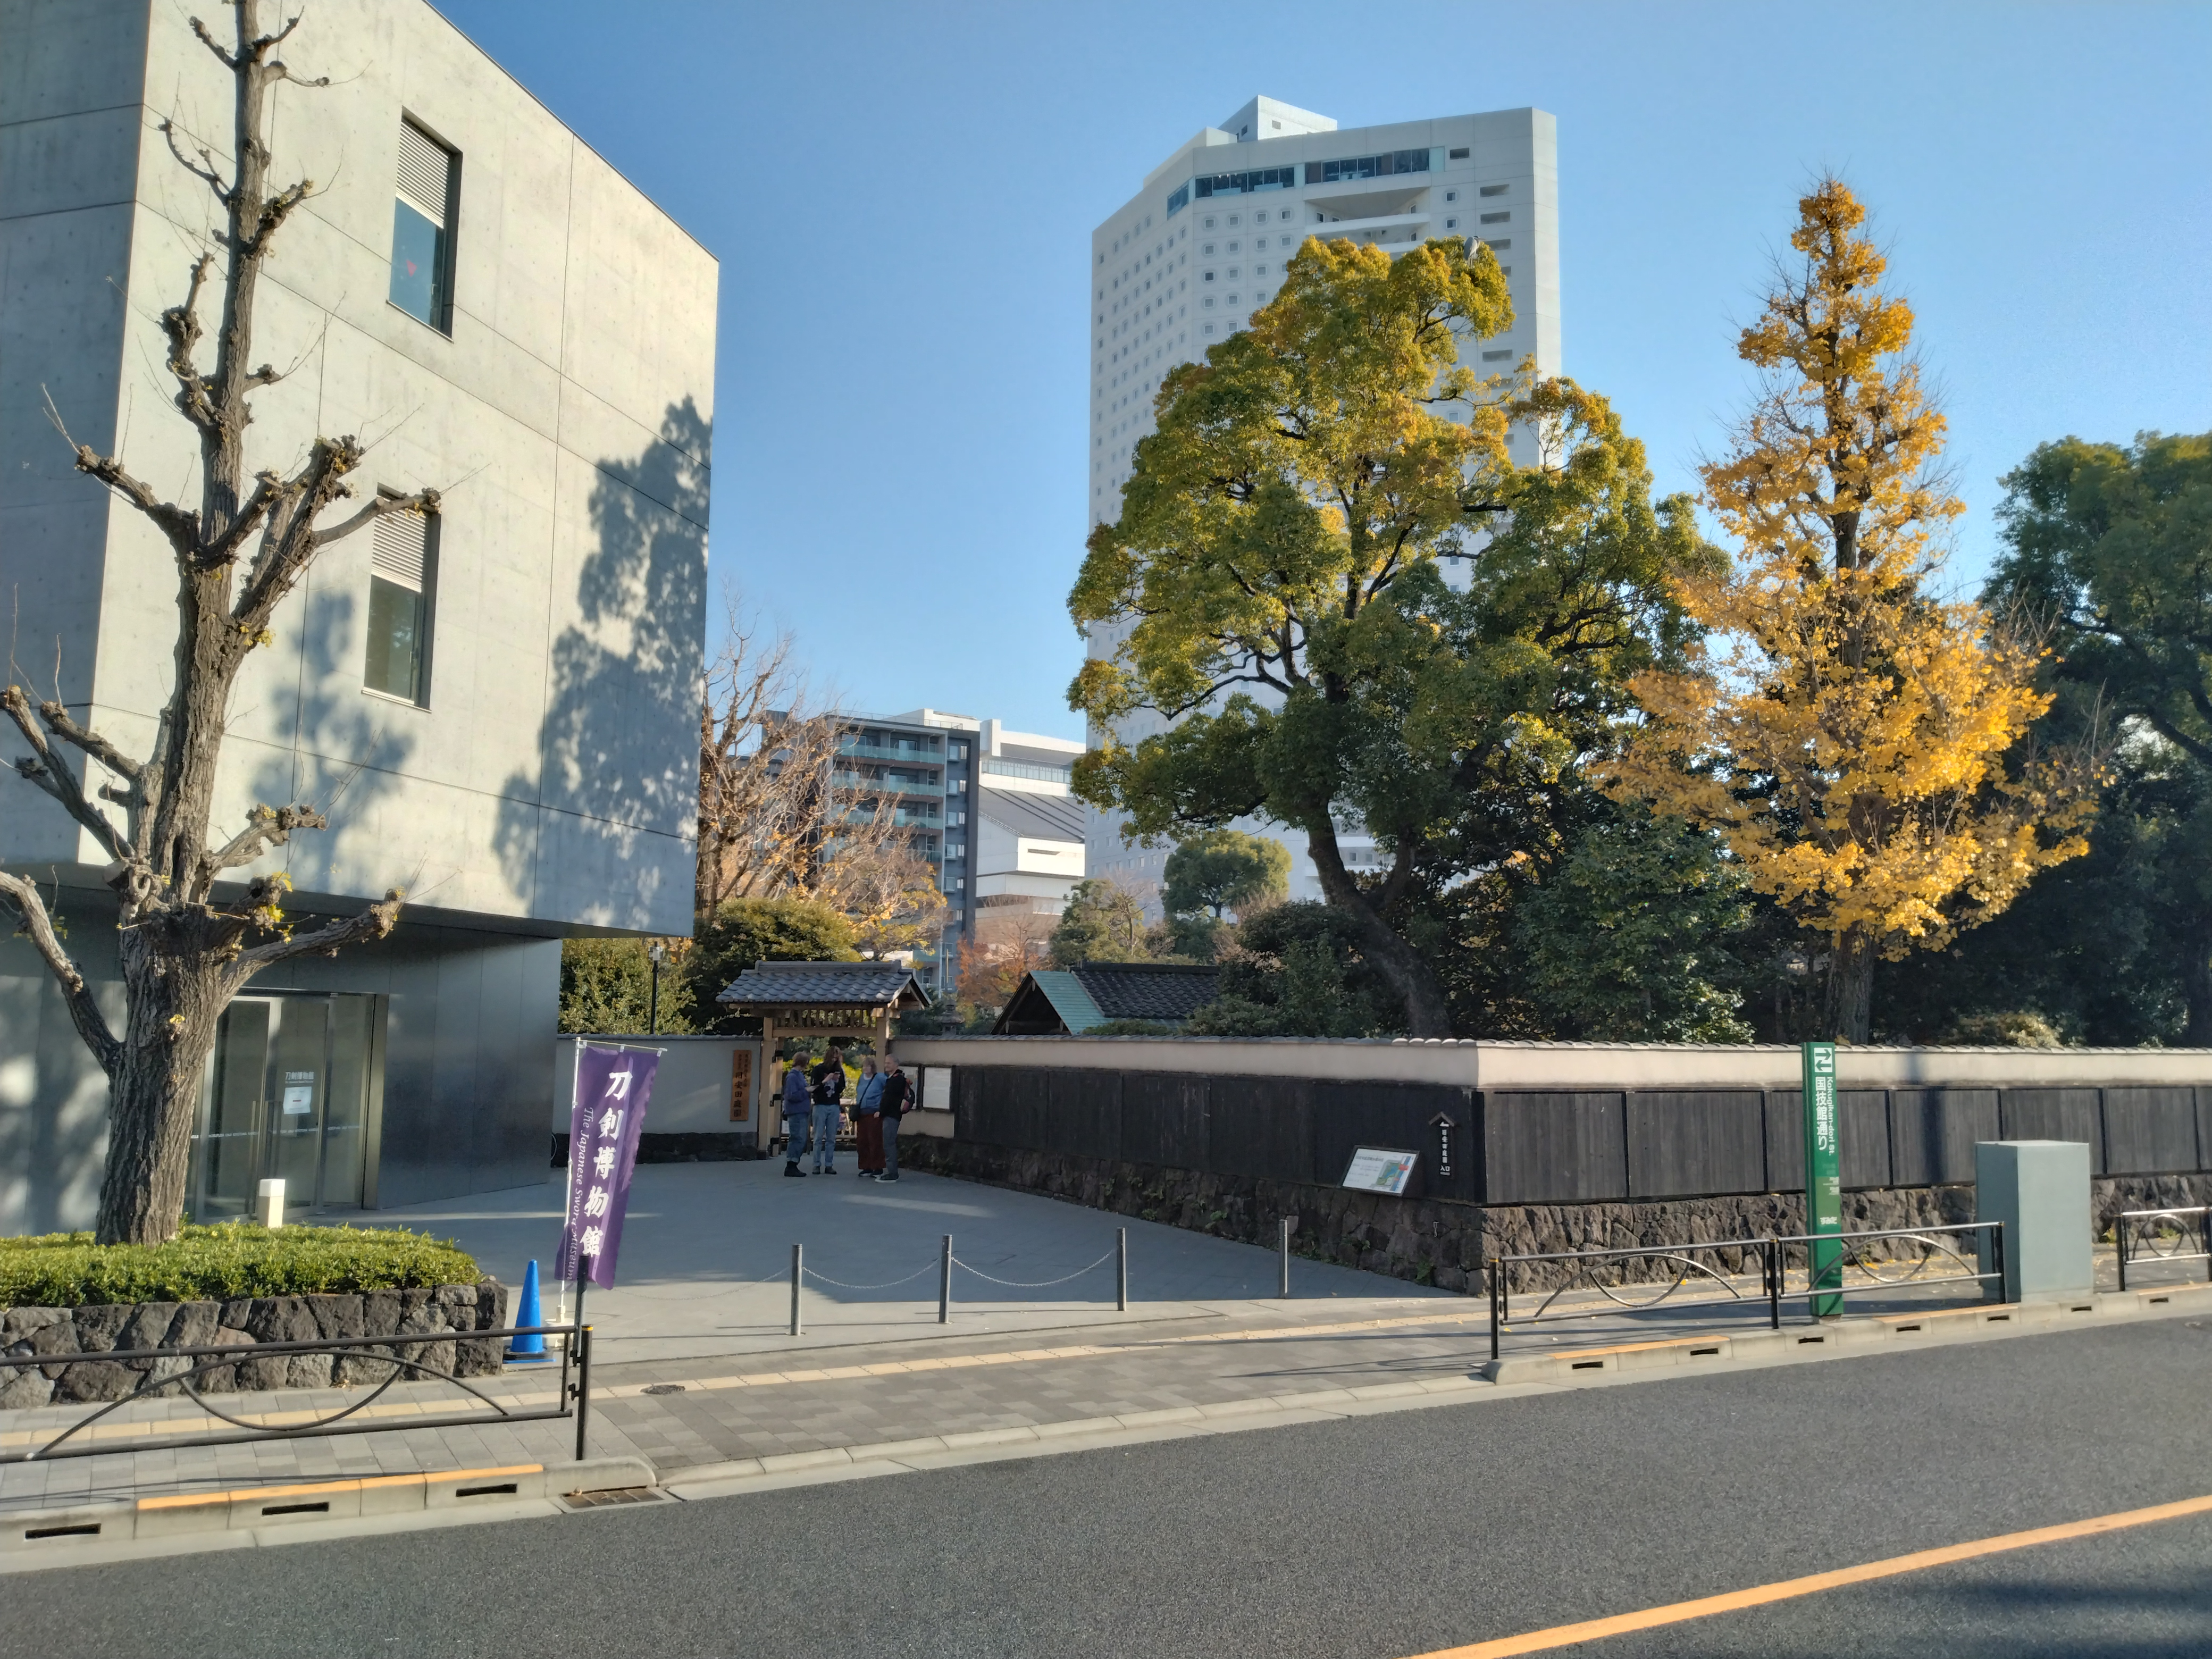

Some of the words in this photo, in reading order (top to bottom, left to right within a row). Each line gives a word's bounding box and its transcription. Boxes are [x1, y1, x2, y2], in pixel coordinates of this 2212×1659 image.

[583, 1107, 594, 1128] The
[1815, 1076, 1828, 1151] 国技館通り
[576, 1129, 590, 1185] Japanese
[579, 1070, 633, 1258] 刀剣博物館
[566, 1228, 579, 1280] Museum
